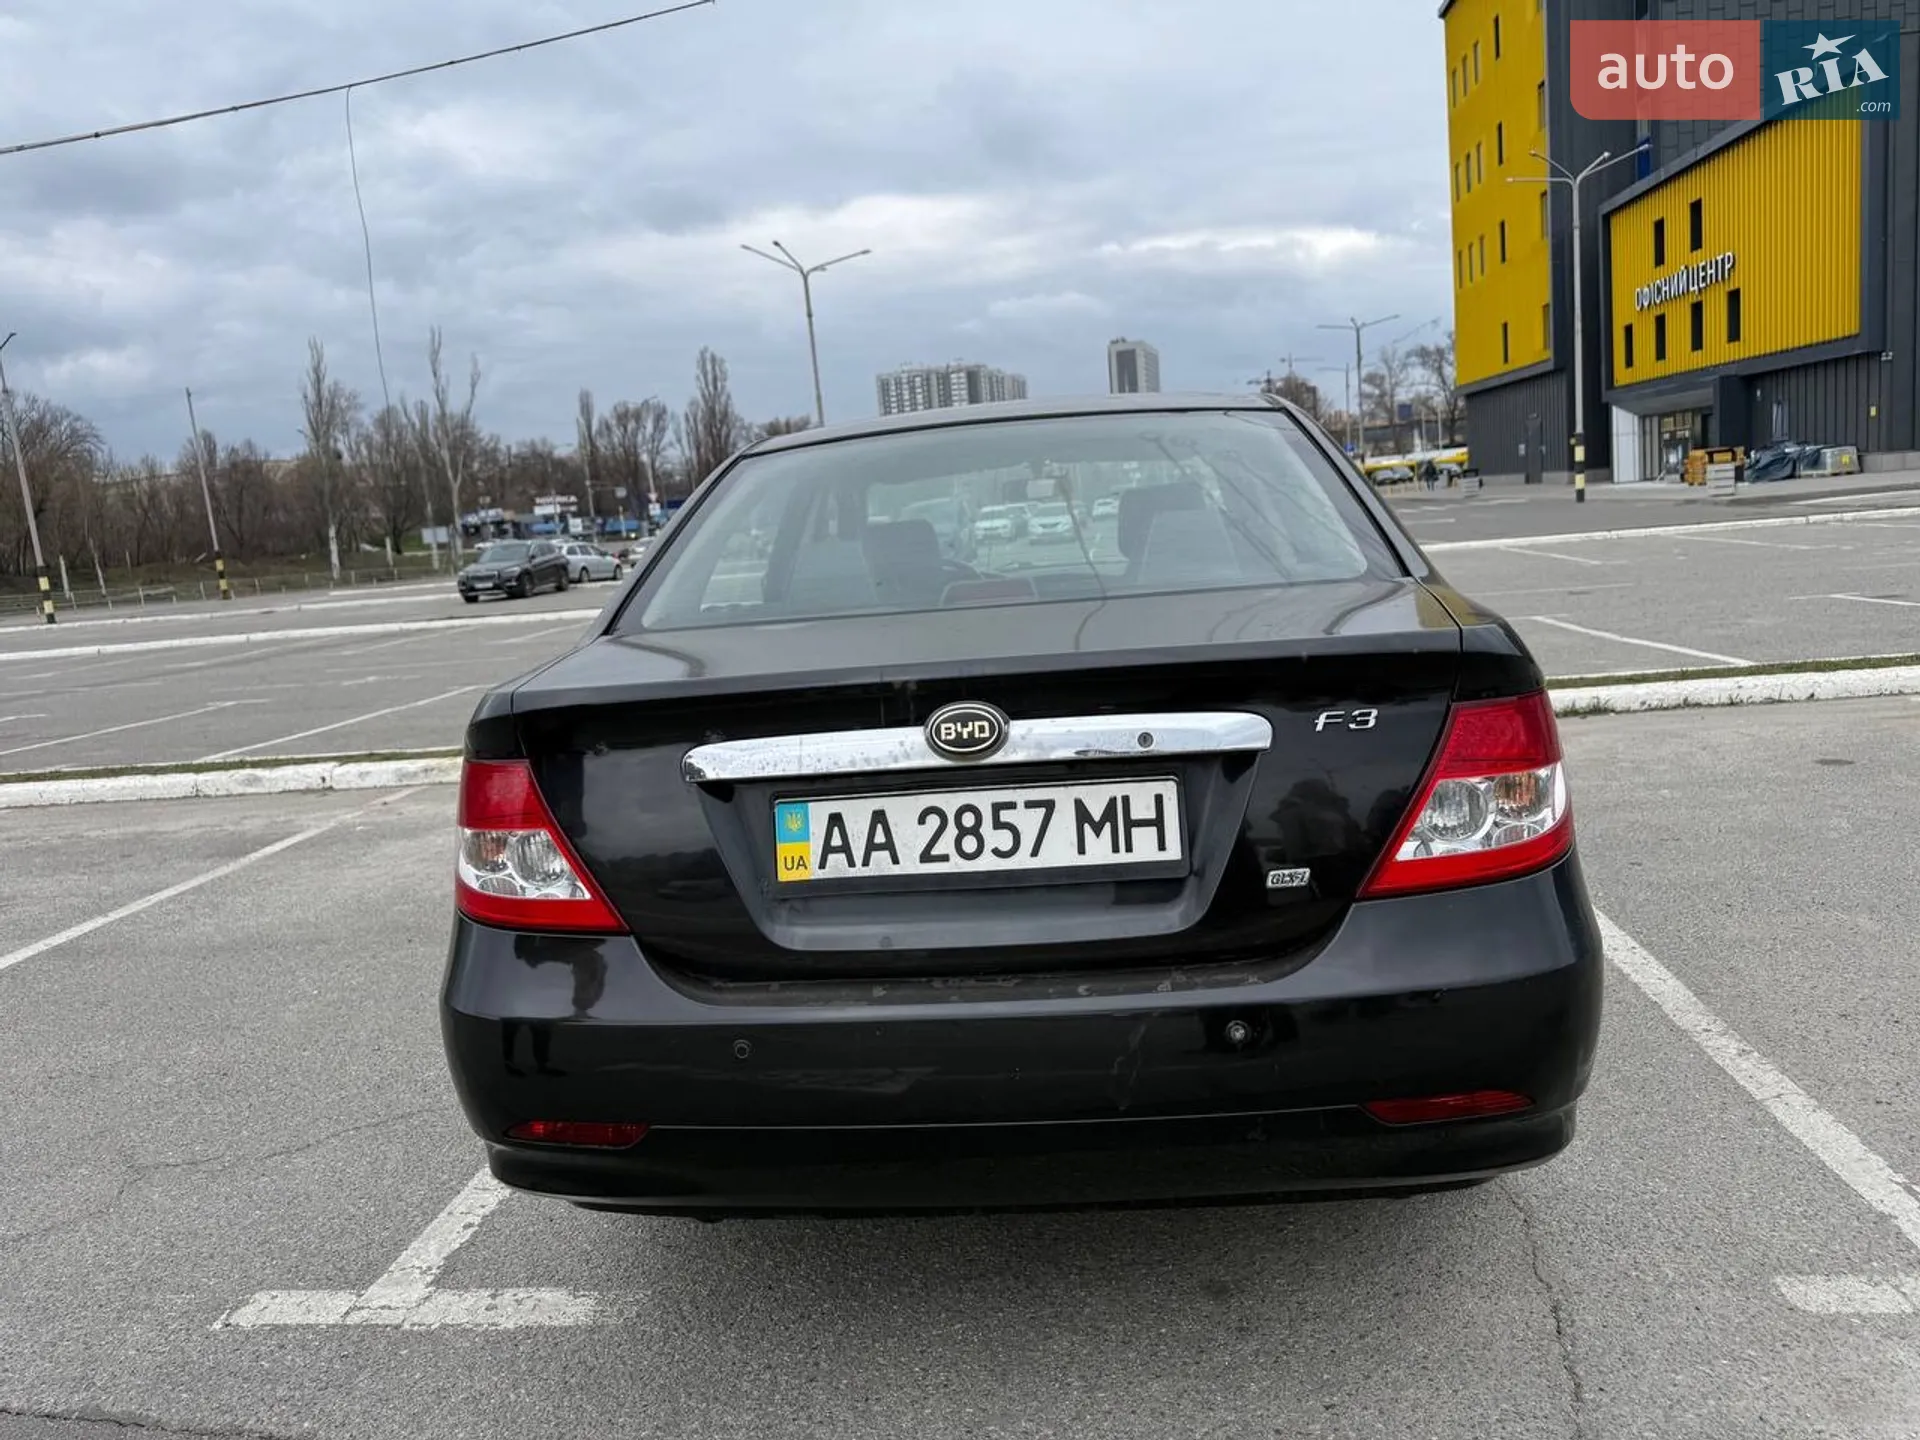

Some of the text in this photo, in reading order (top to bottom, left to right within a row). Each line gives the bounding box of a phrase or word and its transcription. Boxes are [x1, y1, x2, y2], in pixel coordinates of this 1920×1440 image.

[1635, 252, 1734, 311] ОФІСНИЙ ЦЕНТР
[940, 721, 990, 741] BYD
[1314, 708, 1378, 732] F3
[818, 794, 1166, 870] AA 2857 MH
[784, 854, 808, 871] UA
